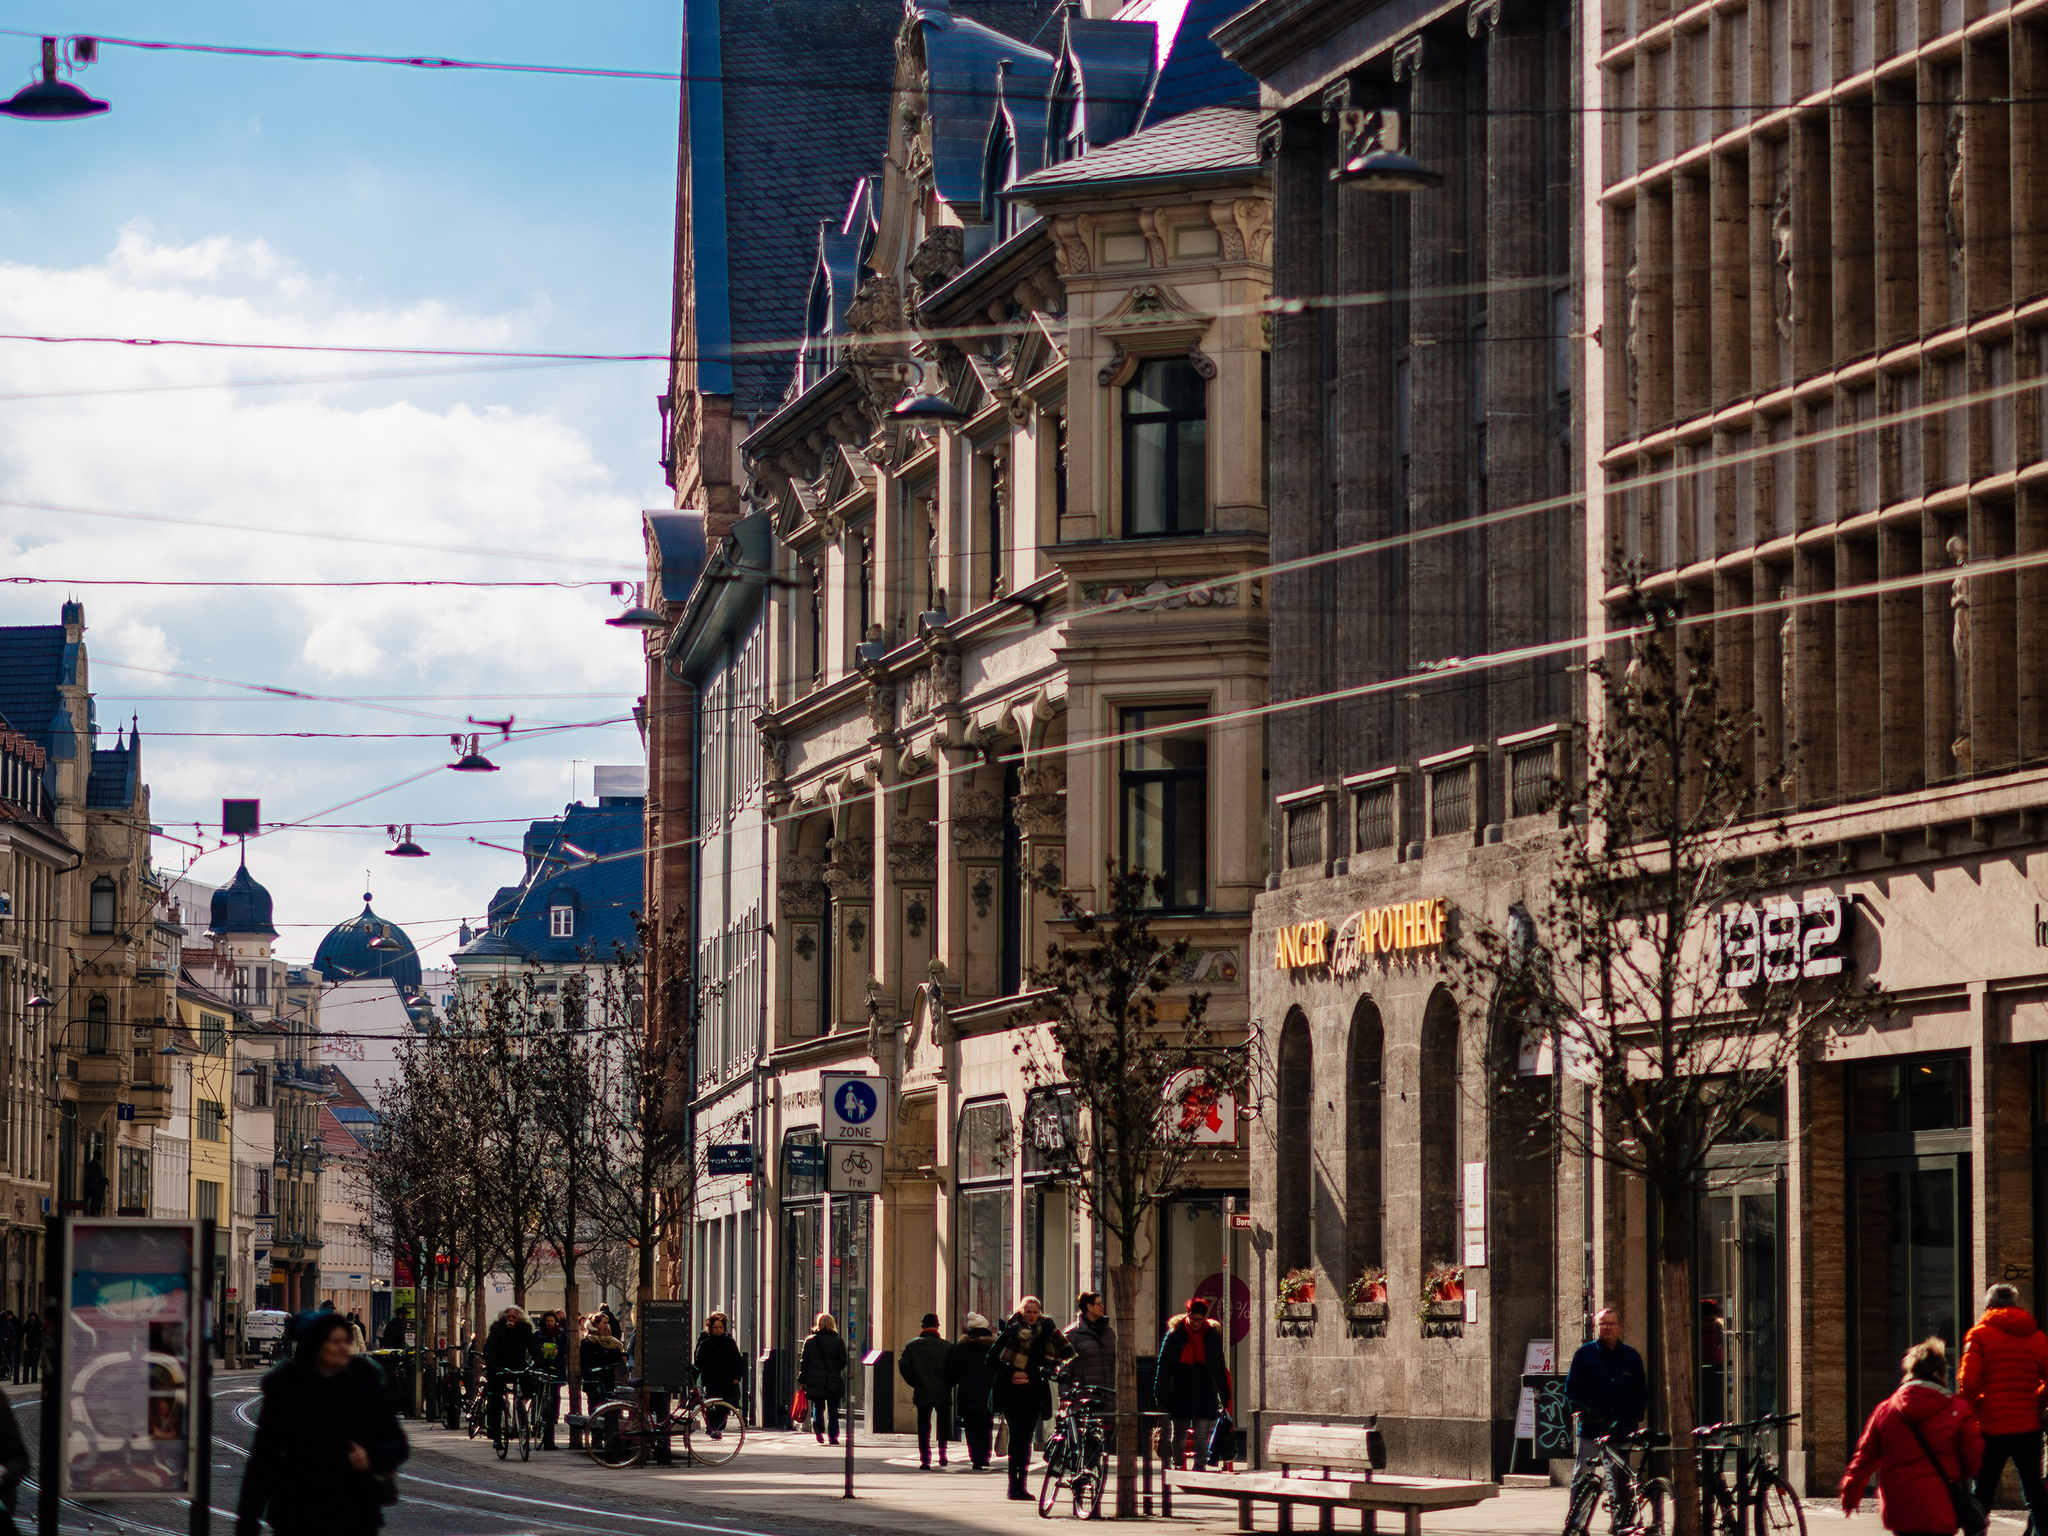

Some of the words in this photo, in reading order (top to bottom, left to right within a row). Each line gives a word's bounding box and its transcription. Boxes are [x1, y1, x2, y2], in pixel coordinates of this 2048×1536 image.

[1275, 919, 1328, 969] ANGER
[1359, 897, 1447, 954] APOTHEKE
[839, 1126, 871, 1138] ZONE
[848, 1175, 866, 1187] frei
